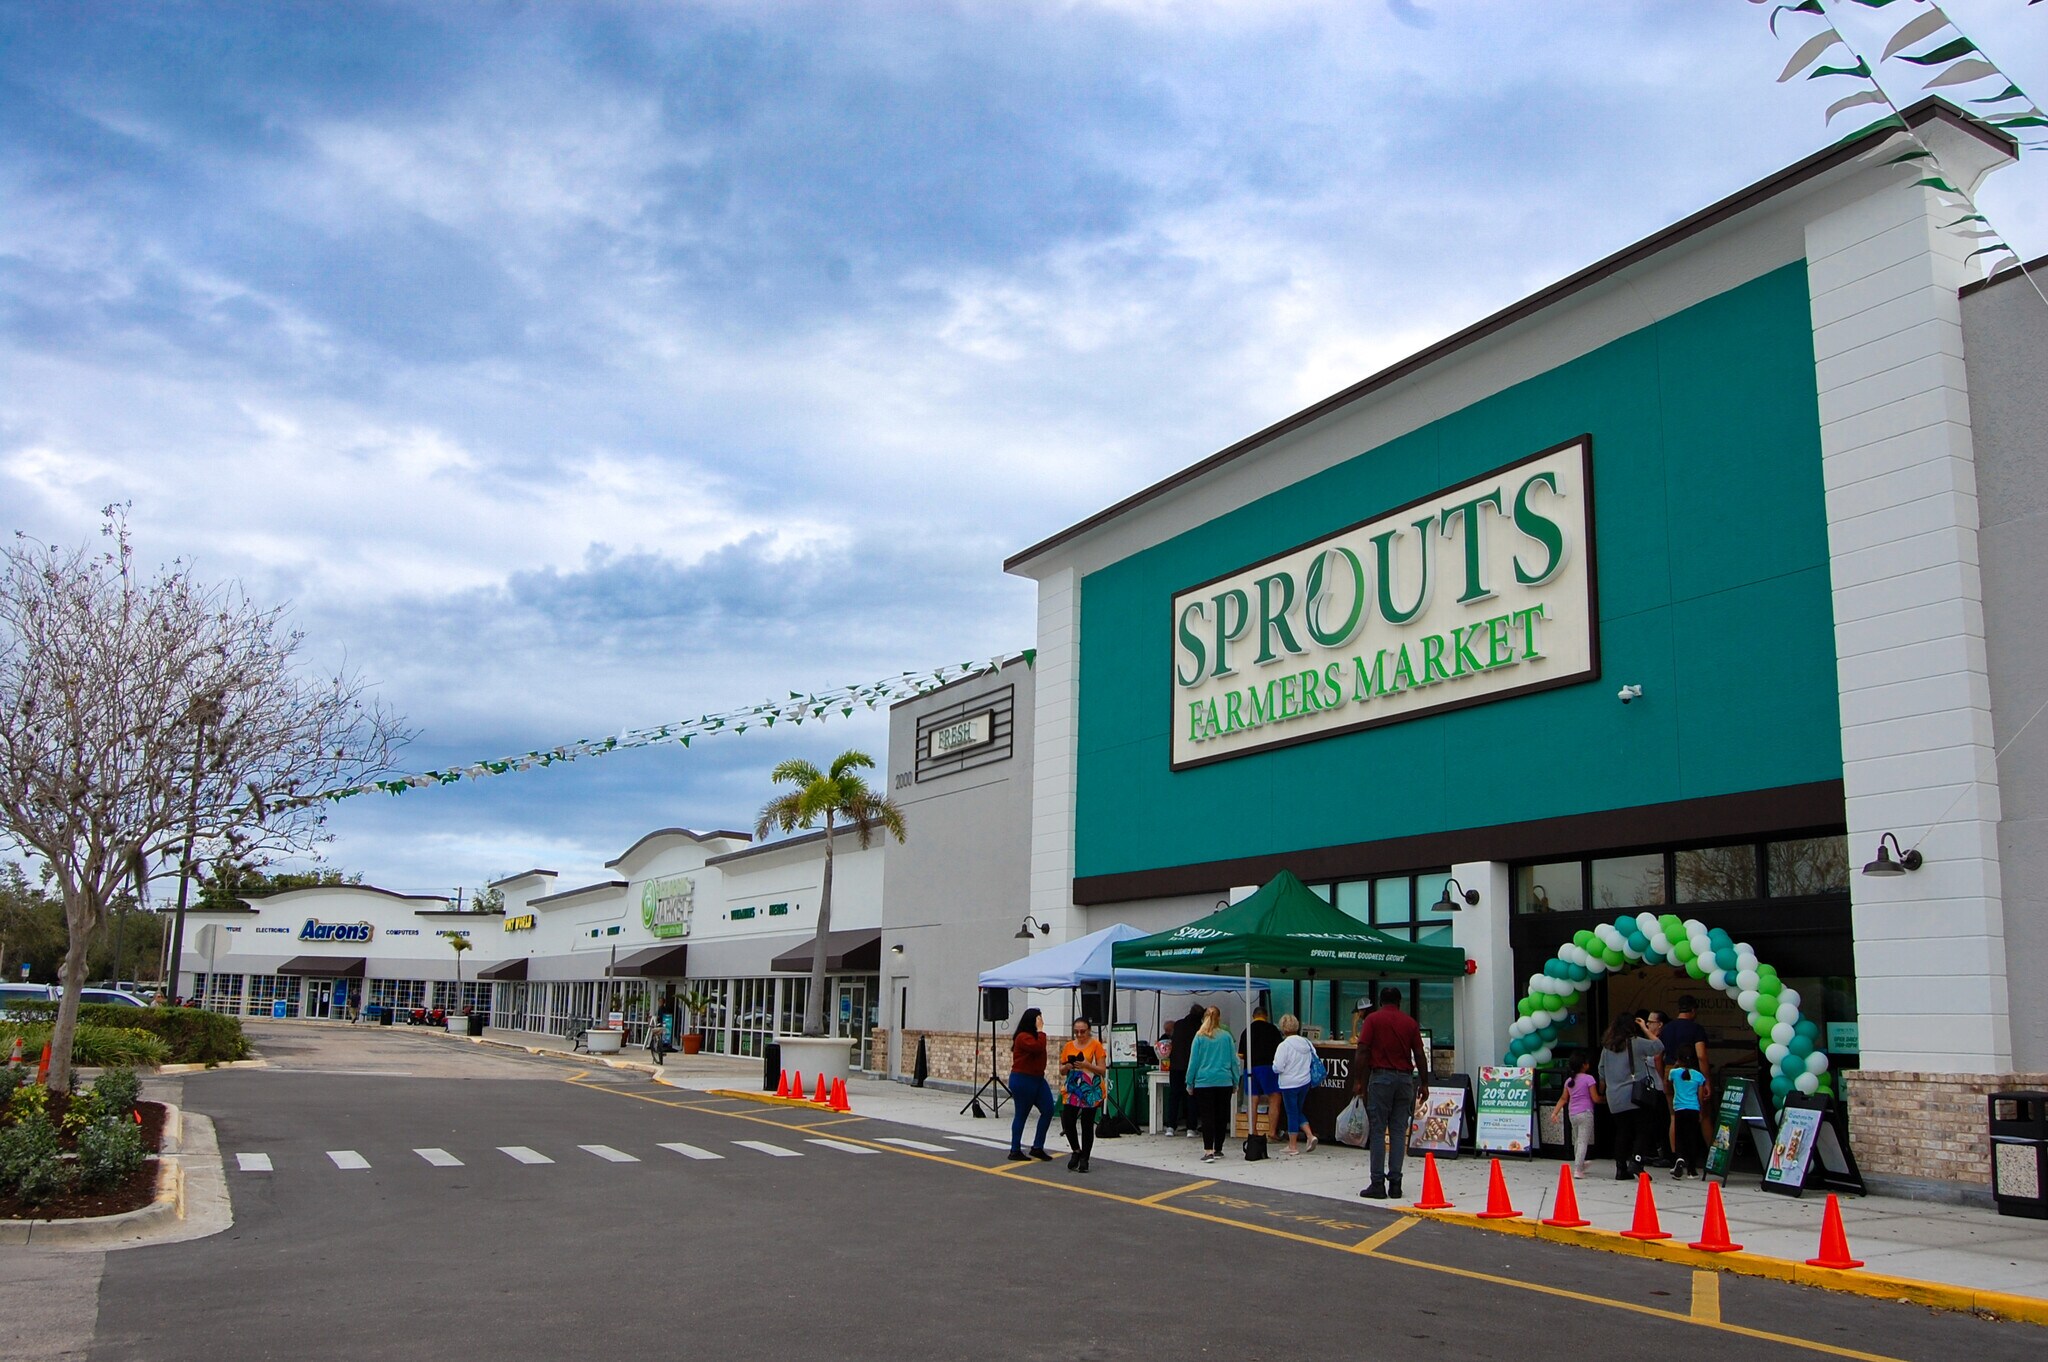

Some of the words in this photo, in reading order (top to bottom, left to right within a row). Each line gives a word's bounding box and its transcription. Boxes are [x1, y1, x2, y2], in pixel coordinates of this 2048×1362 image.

[1177, 471, 1566, 689] SPROUTS
[1188, 662, 1343, 742] FARMERS
[1352, 602, 1545, 702] MARKET
[937, 721, 972, 750] FRESH
[895, 771, 912, 790] 2000
[298, 918, 373, 943] Aaron's
[1338, 951, 1357, 960] WHERE
[1357, 952, 1386, 961] GOODNESS
[1482, 1088, 1505, 1100] 20%
[1507, 1088, 1528, 1100] OFF
